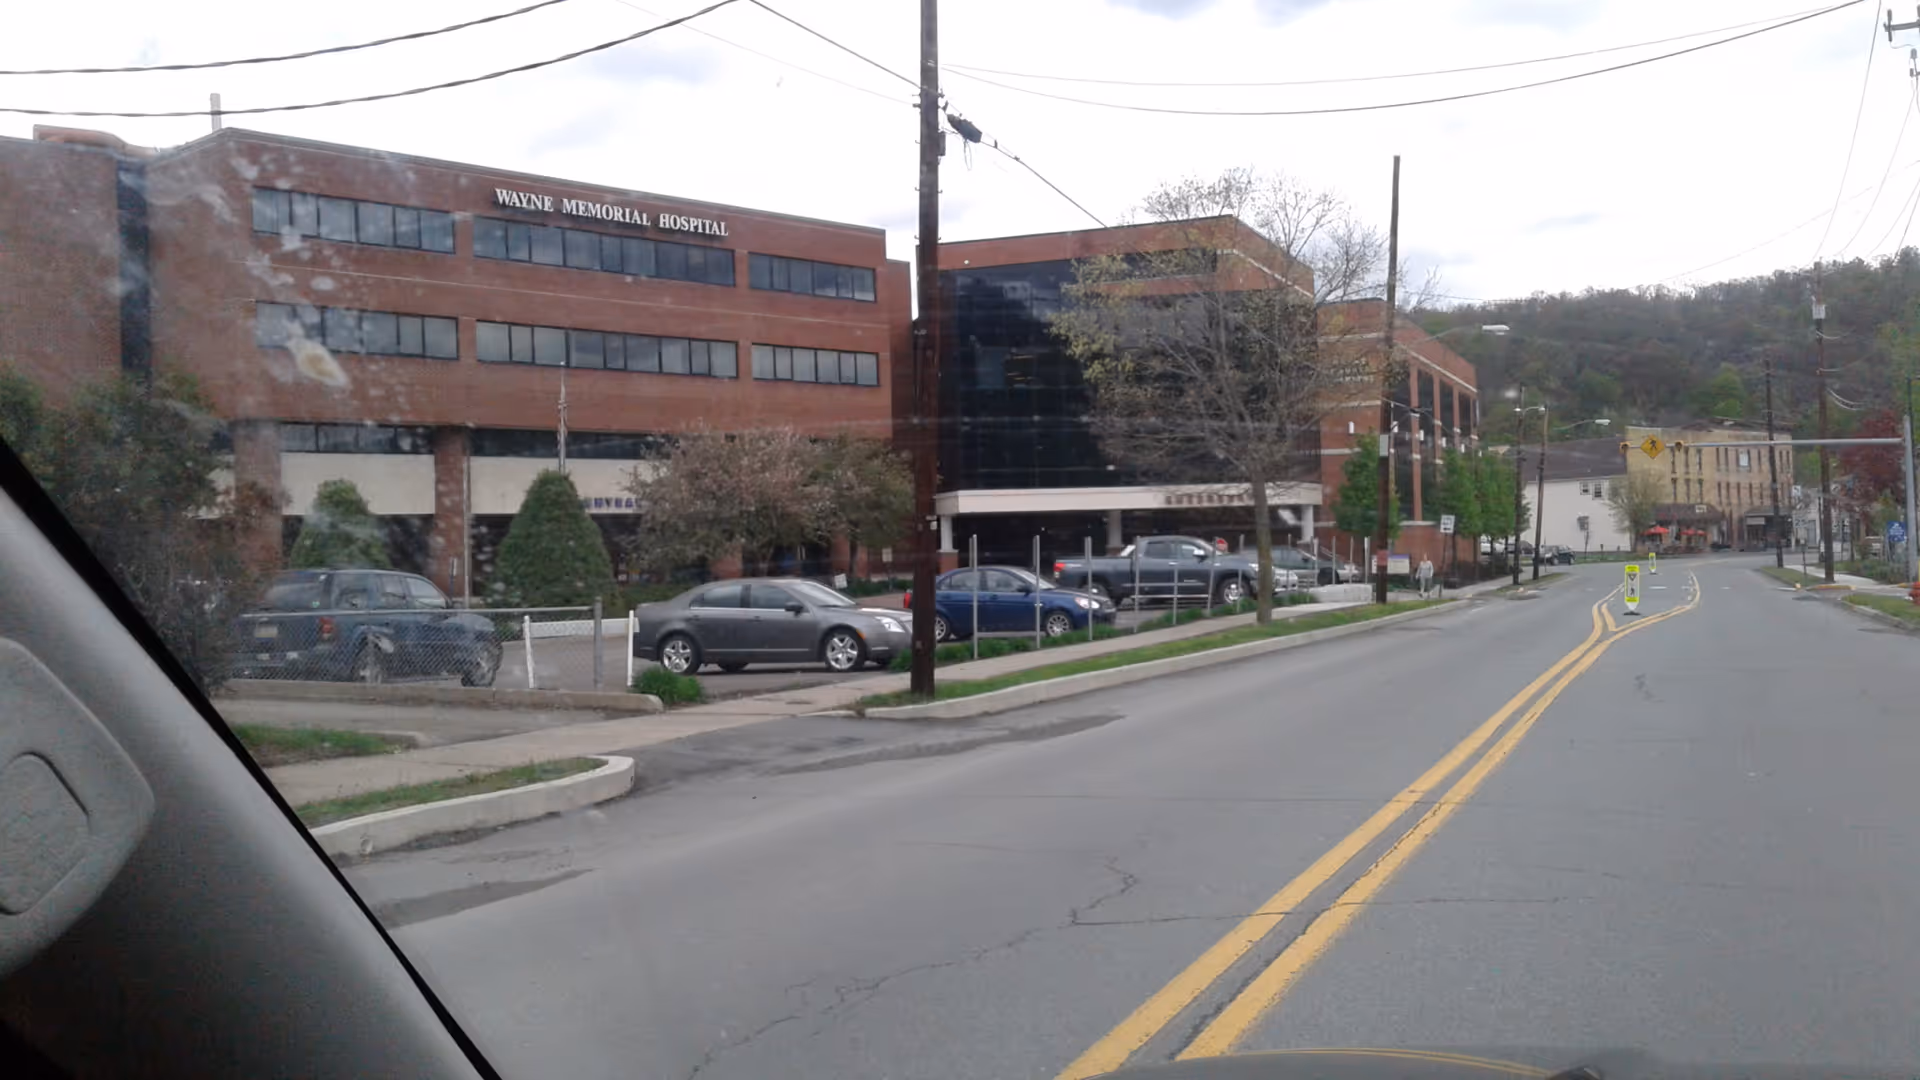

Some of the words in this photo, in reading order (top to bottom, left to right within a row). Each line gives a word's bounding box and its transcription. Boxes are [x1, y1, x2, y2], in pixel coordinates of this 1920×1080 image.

[495, 188, 553, 212] WAYNE
[562, 198, 651, 225] MEMORIAL
[659, 213, 729, 236] HOSPITAL
